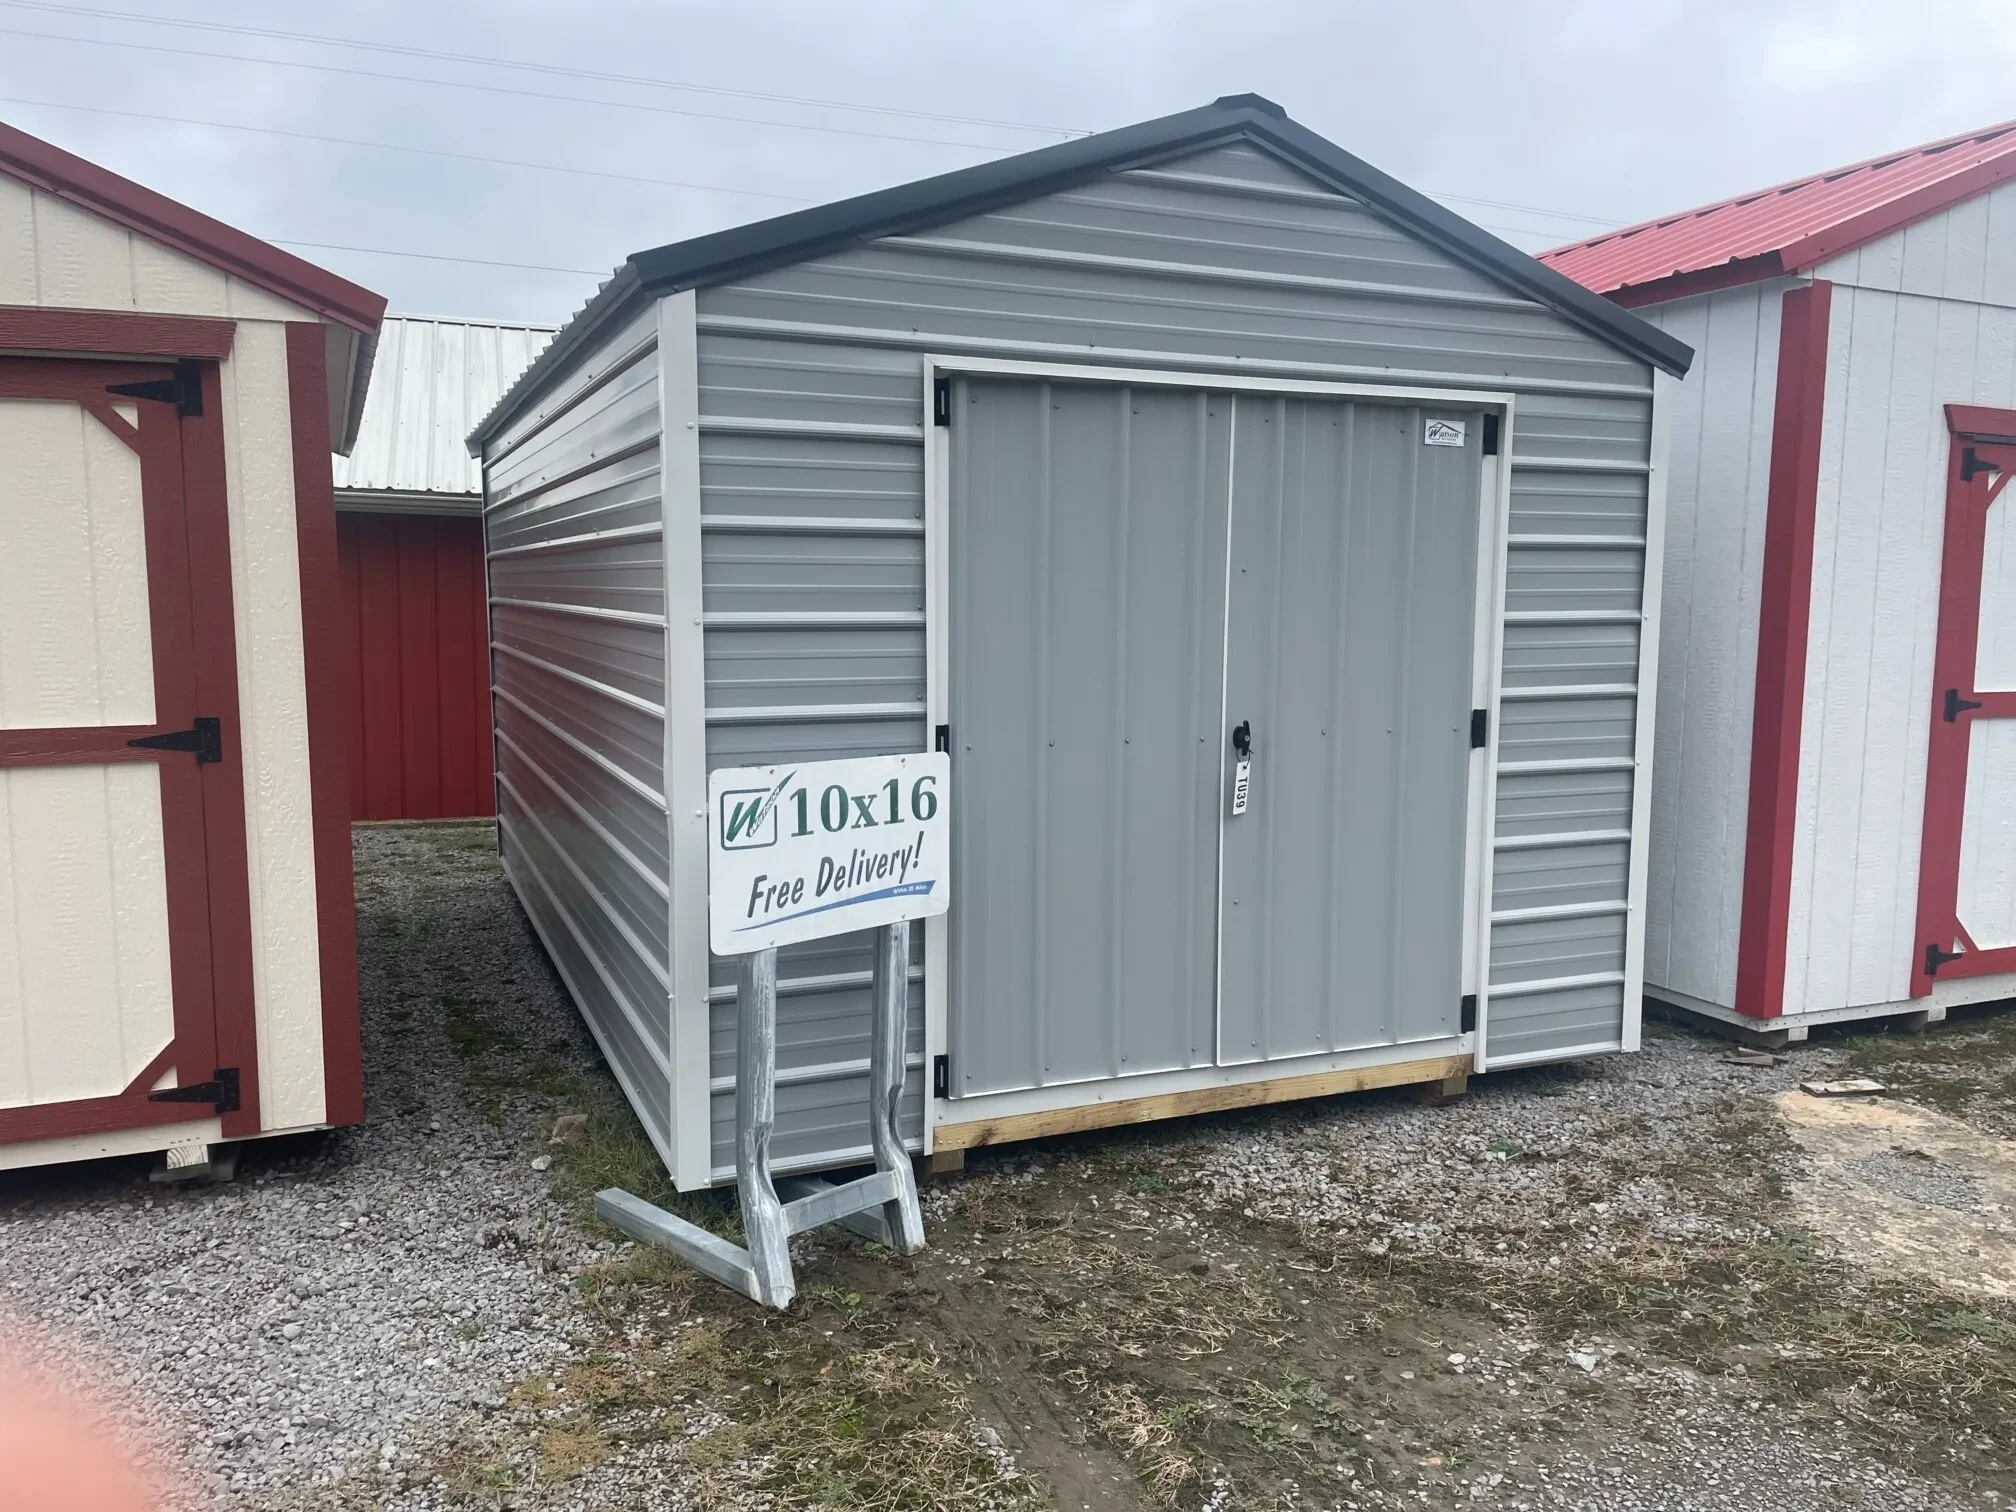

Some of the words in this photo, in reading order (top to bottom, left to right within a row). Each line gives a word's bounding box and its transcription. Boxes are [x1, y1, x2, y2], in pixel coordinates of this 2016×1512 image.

[1429, 426, 1459, 439] Watson
[789, 775, 938, 837] 10x16
[1236, 777, 1248, 808] TU39
[747, 874, 805, 918] Free
[815, 830, 925, 898] Delivery!
